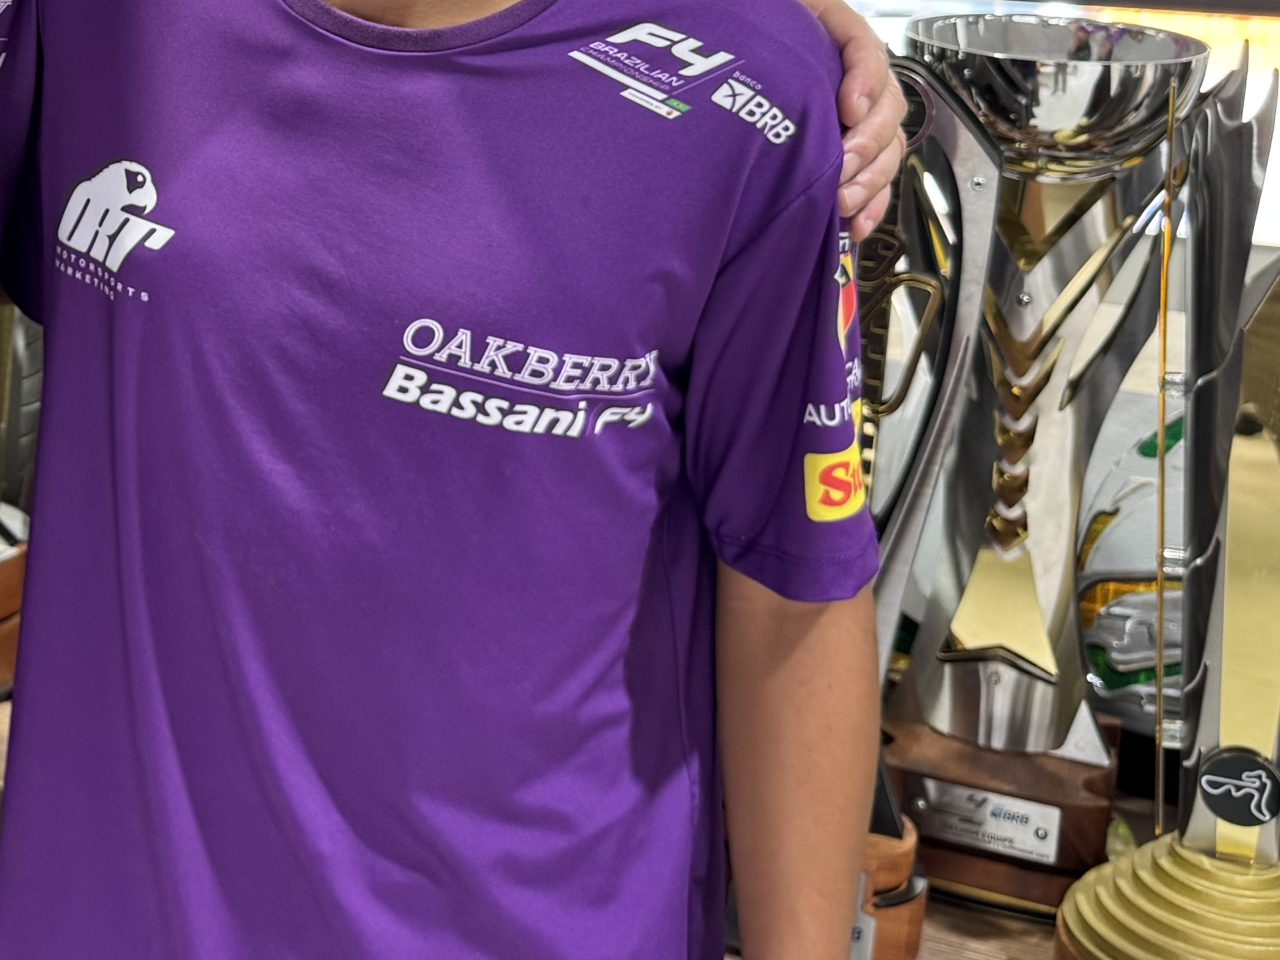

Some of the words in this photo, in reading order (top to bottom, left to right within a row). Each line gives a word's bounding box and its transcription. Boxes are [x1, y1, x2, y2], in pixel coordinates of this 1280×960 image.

[589, 41, 685, 87] BRAZILIAN
[605, 22, 736, 77] F4
[738, 94, 796, 145] BRB
[55, 258, 115, 301] MARKETING
[56, 245, 150, 302] MOTORSPORTS
[403, 318, 660, 392] OAKBERRY
[382, 363, 588, 438] Bassani
[594, 401, 653, 435] F4
